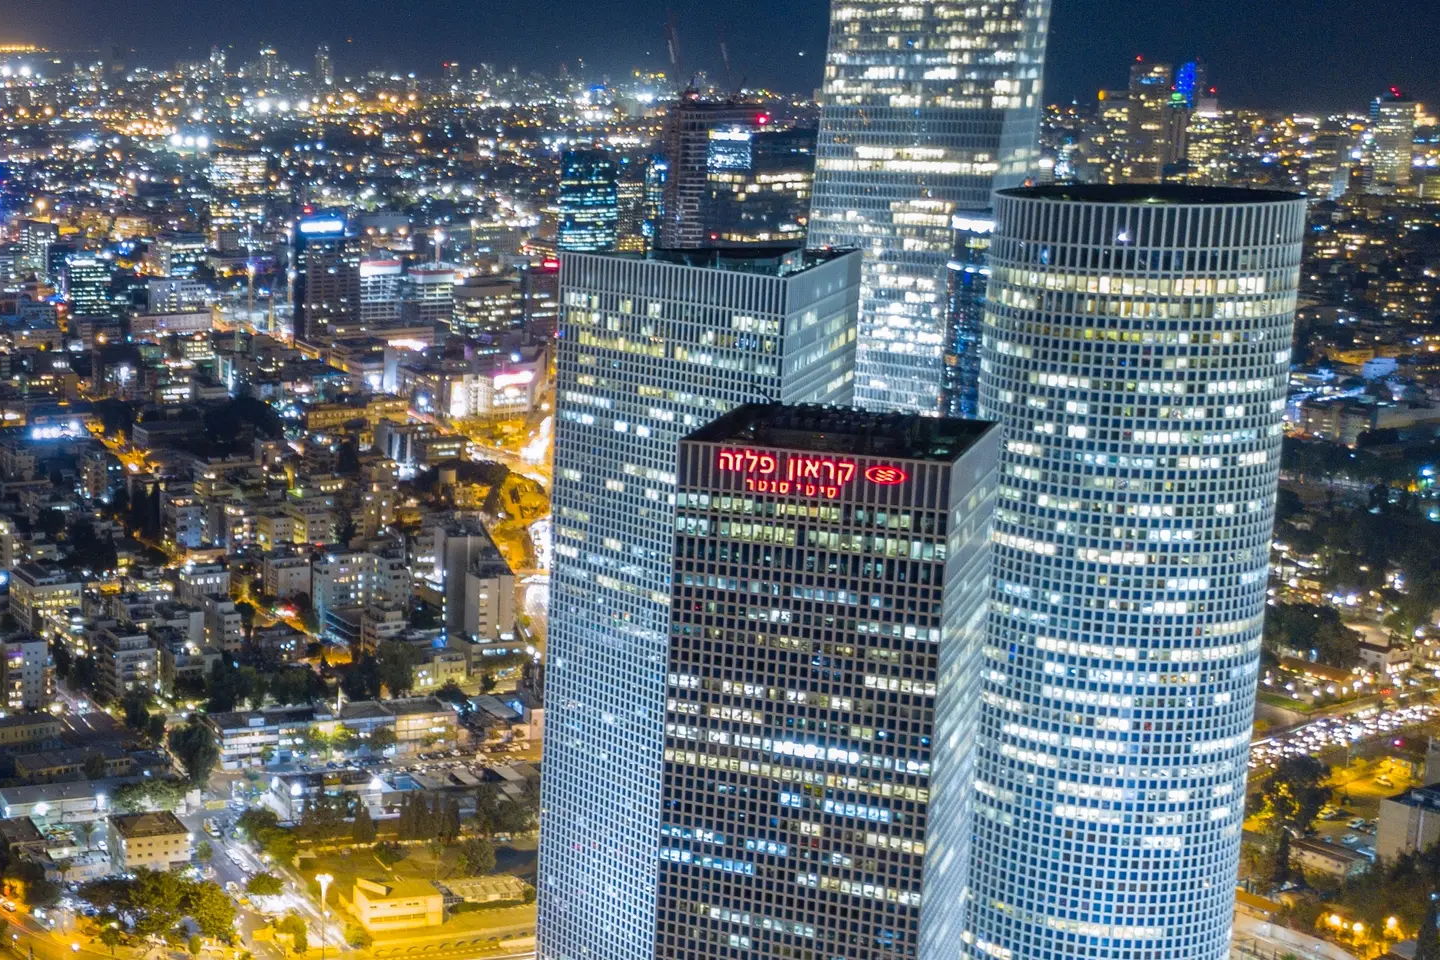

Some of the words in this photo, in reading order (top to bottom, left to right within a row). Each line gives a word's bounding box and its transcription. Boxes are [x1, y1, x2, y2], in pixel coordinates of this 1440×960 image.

[719, 451, 776, 474] פלזה
[789, 458, 855, 485] קראון
[747, 478, 790, 494] סנטר
[796, 483, 838, 498] סיטי
